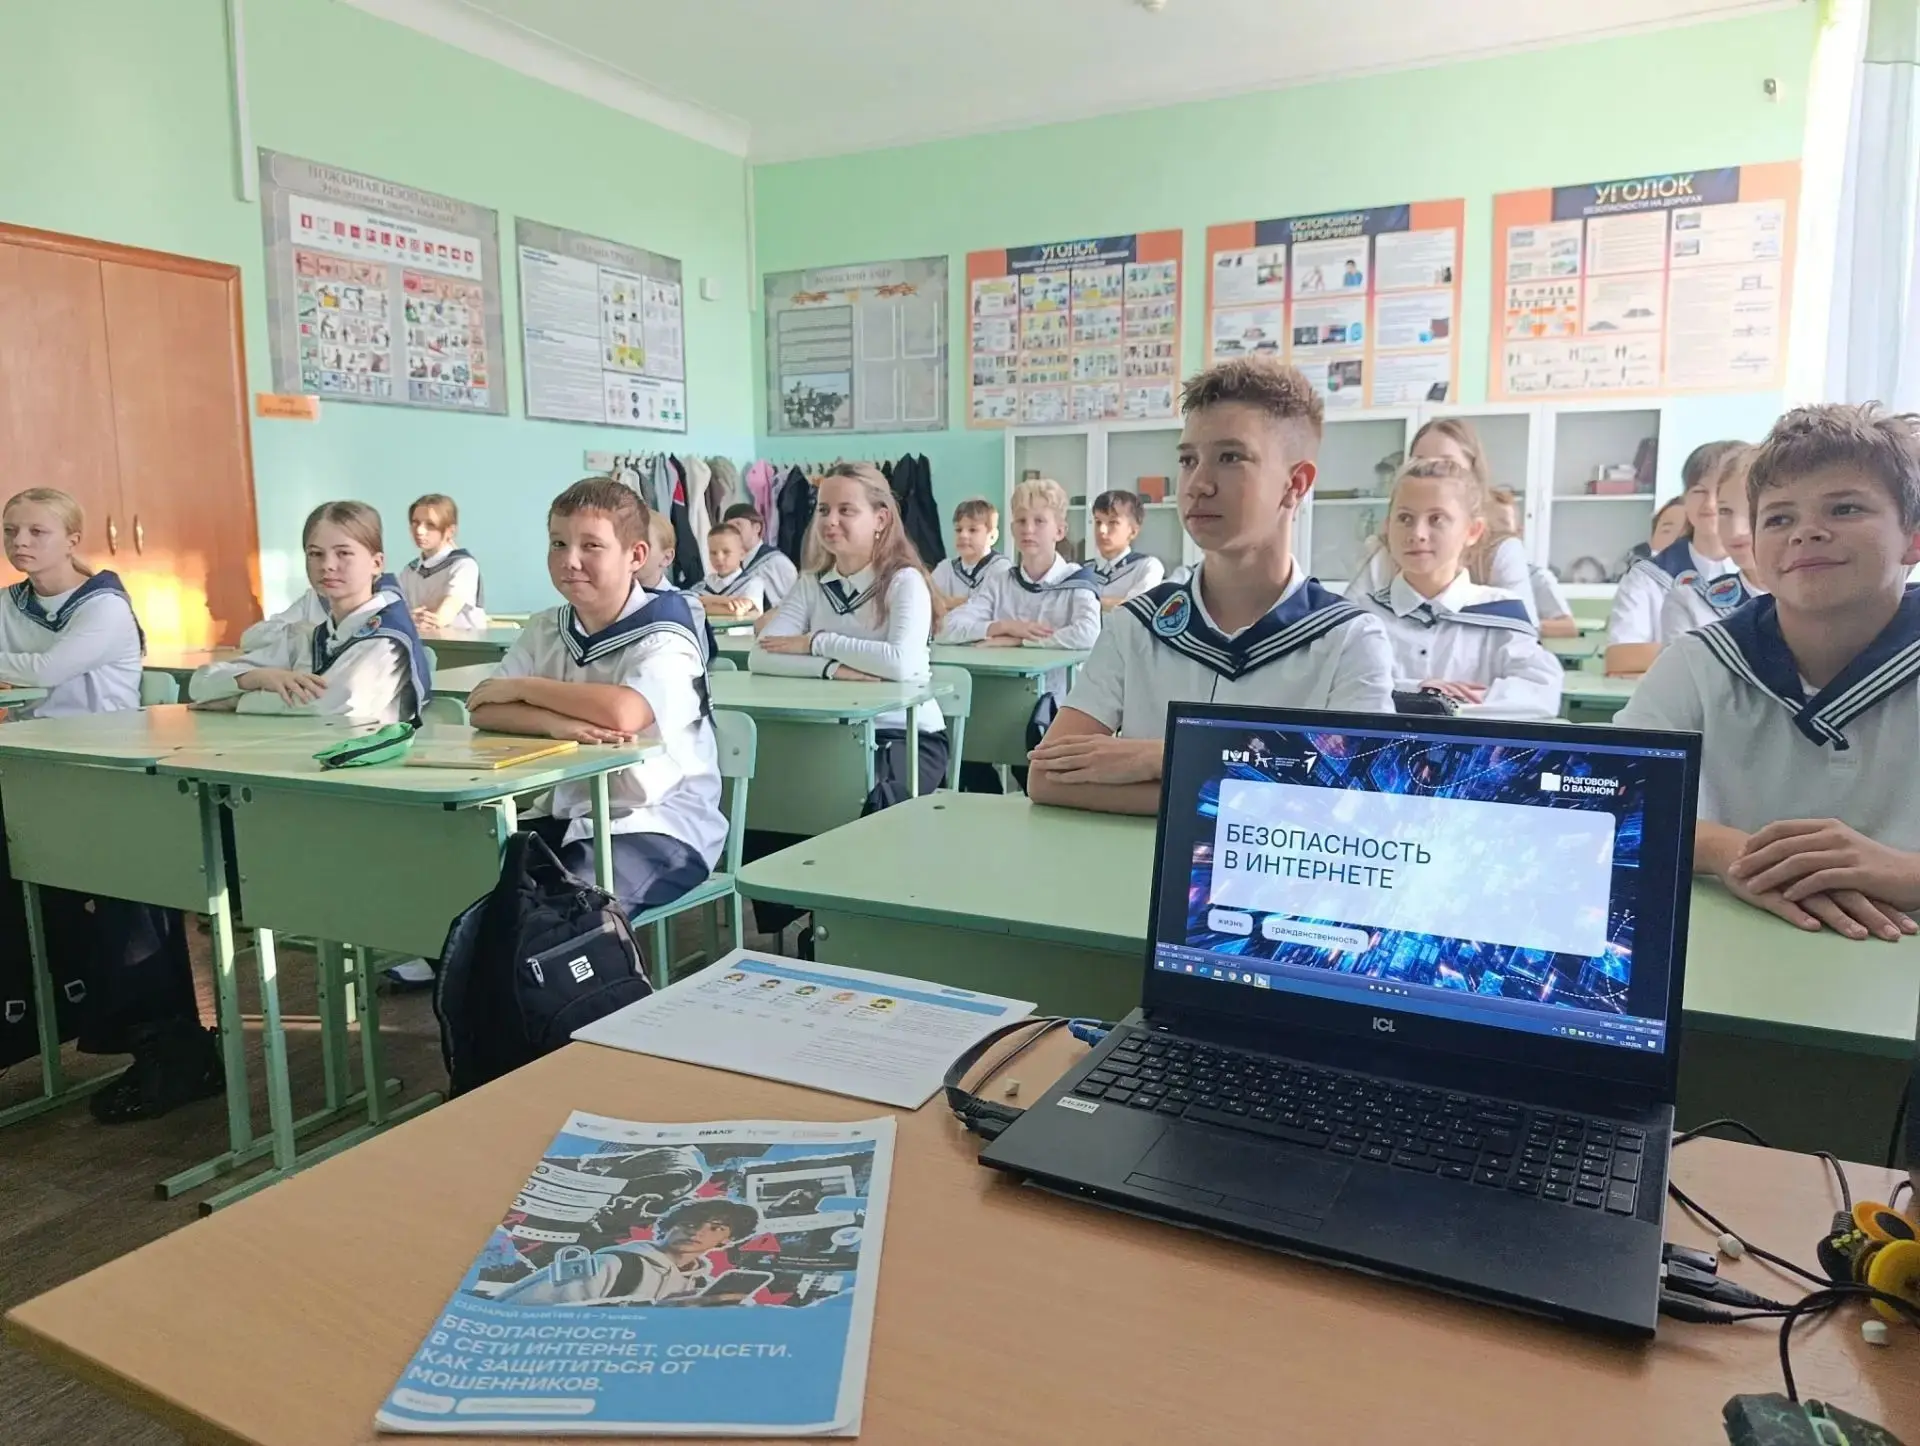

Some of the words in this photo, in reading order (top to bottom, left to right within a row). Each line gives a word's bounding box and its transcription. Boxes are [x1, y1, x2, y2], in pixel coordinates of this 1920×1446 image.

[1594, 174, 1694, 205] УГОЛОК
[1040, 240, 1098, 260] УГОЛОК
[1562, 776, 1619, 787] РАЗГОВОРЫ
[1562, 783, 1570, 792] О
[1571, 784, 1614, 796] ВАЖНОМ
[1226, 823, 1431, 864] БЕЗОПАСНОСТЬ
[1224, 849, 1238, 869] В
[1246, 852, 1394, 889] ИНТЕРНЕТЕ
[1217, 918, 1243, 929] жизнь
[1271, 925, 1359, 946] гражданственность
[1372, 1016, 1396, 1033] ICL
[441, 1314, 637, 1340] БЕЗОПАСНОСТЬ
[430, 1331, 449, 1346] В
[454, 1337, 519, 1355] СЕТИ
[666, 1343, 793, 1360] СОЦСЕТИ.
[419, 1347, 474, 1371] КАК
[476, 1358, 655, 1375] ЗАЩИТИТЬСЯ
[660, 1360, 696, 1374] ОТ
[407, 1365, 605, 1392] МОШЕННИКОВ.
